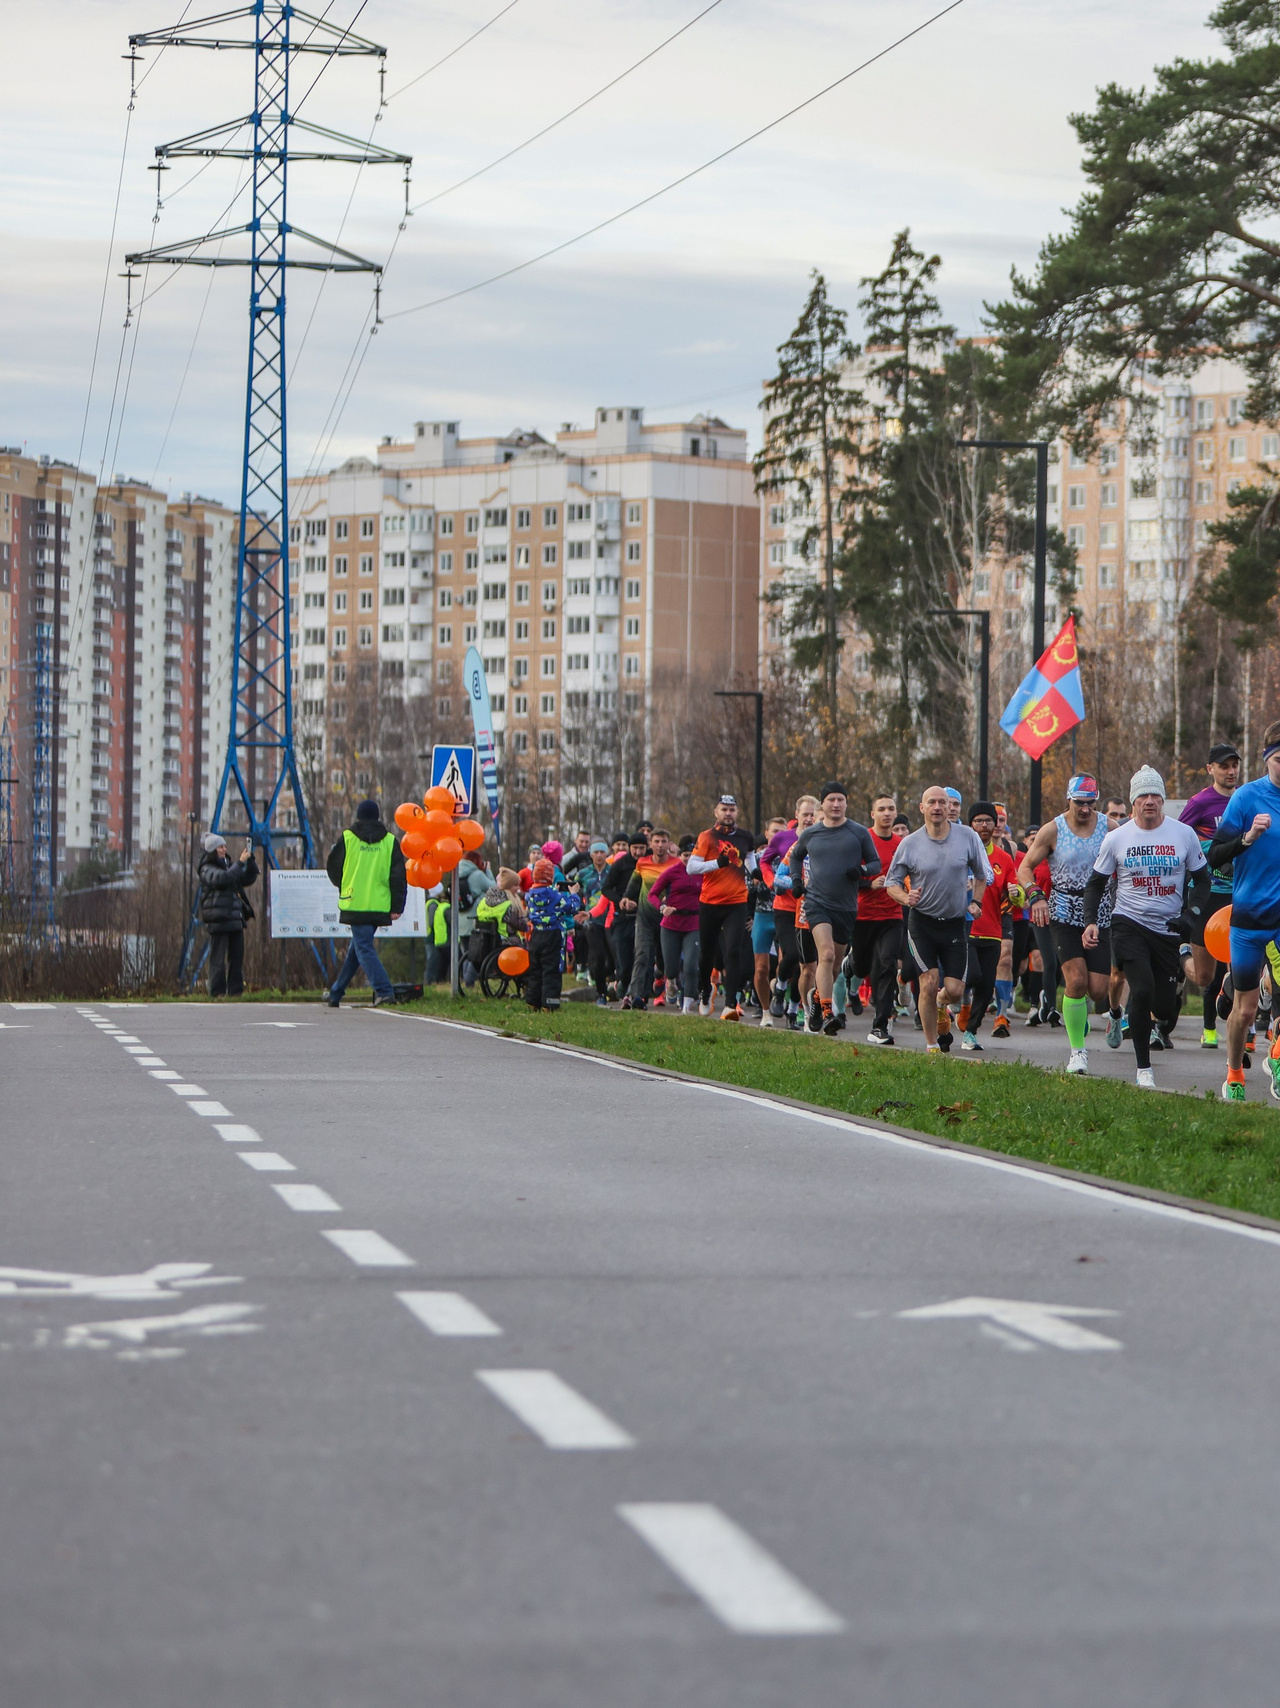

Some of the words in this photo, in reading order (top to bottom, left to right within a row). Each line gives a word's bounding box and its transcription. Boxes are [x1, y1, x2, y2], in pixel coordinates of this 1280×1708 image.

[1126, 845, 1176, 857] #ЗАБЕГ2025
[1124, 856, 1140, 868] 45%
[1141, 856, 1180, 867] ПЛАНЕТЫ
[1149, 866, 1173, 876] БЕГУТ
[1131, 877, 1161, 887] ВМЕСТЕ
[1154, 884, 1176, 896] ТОБОЙ
